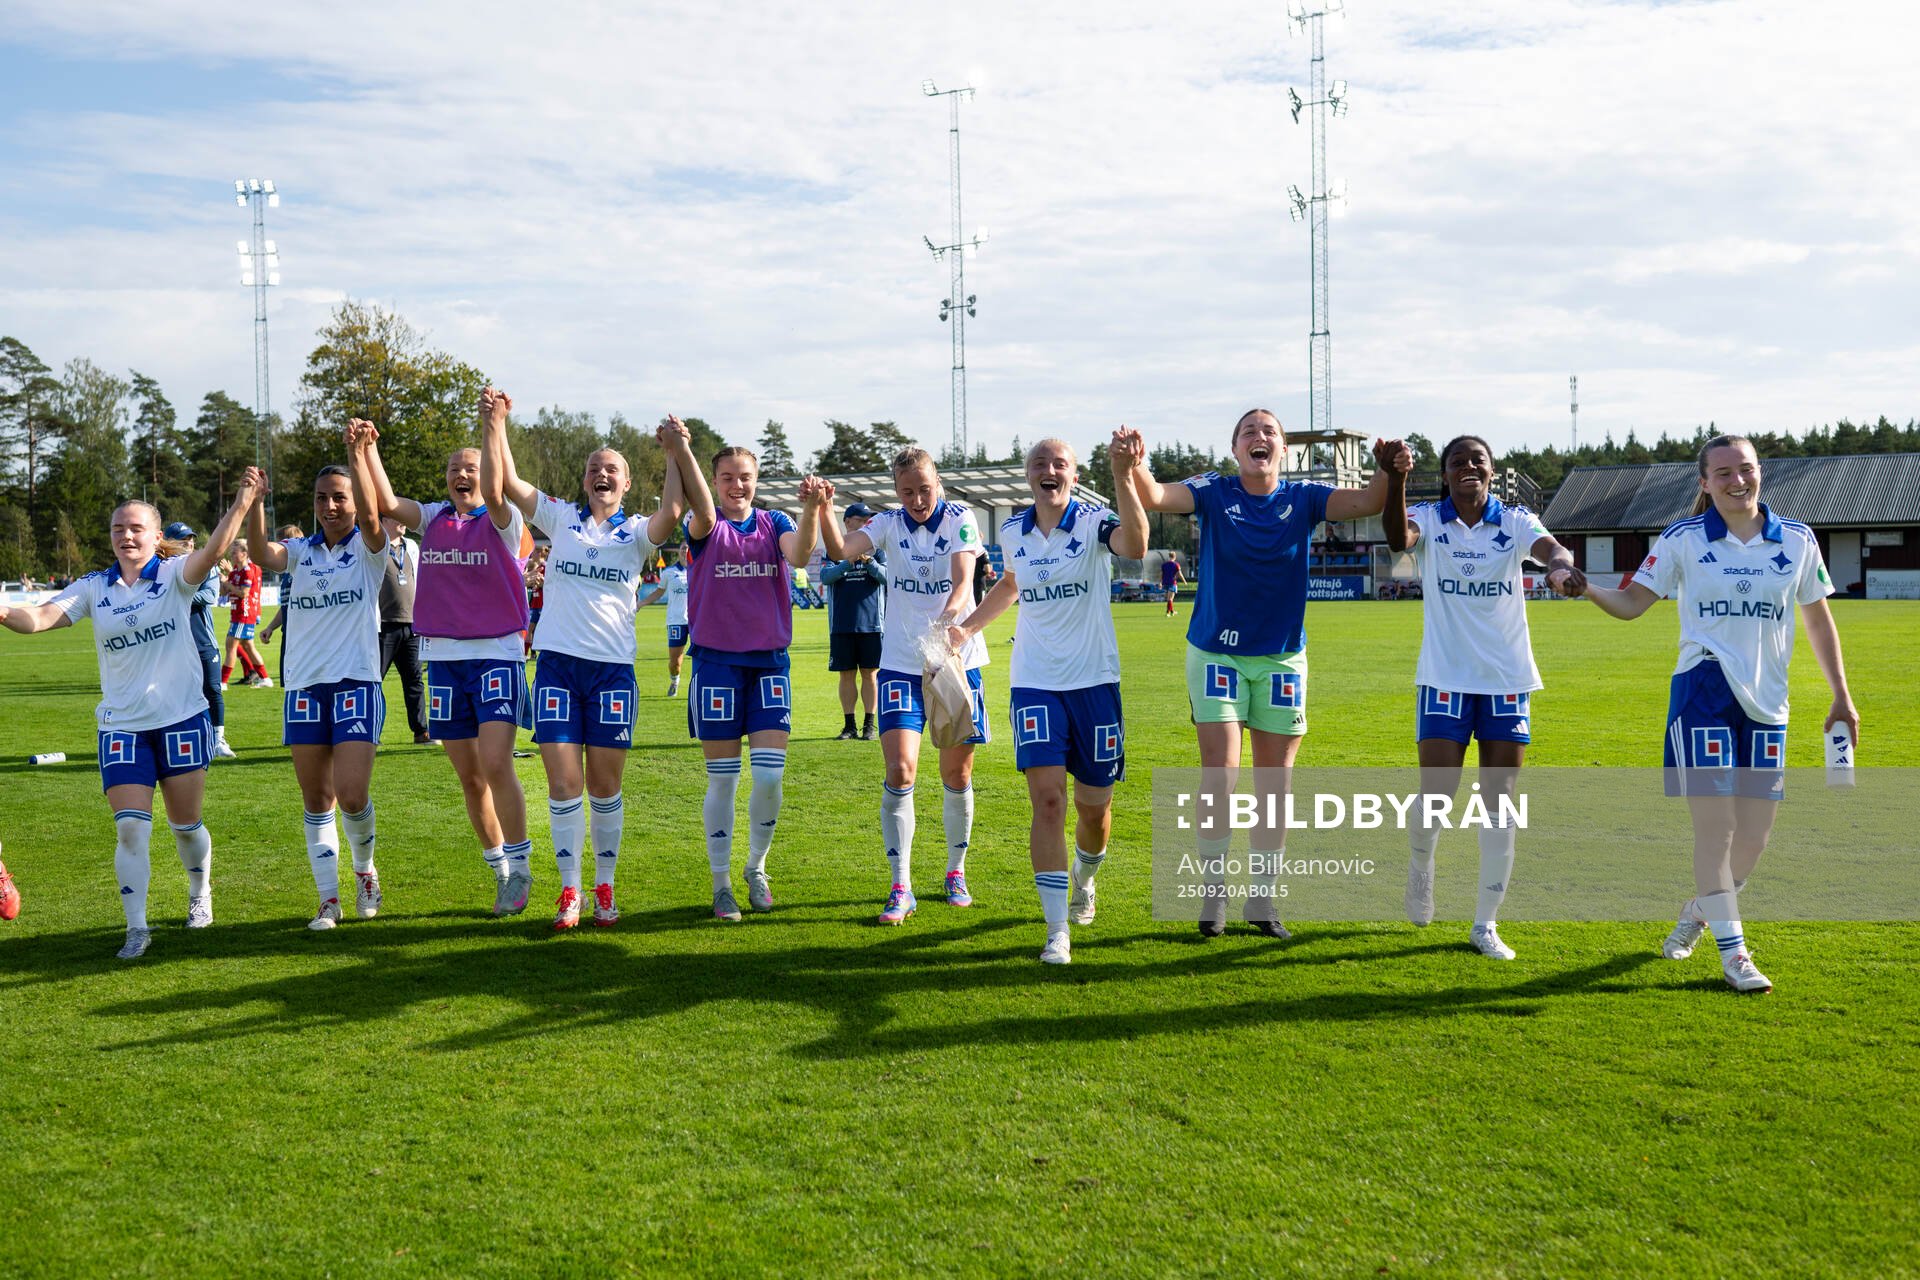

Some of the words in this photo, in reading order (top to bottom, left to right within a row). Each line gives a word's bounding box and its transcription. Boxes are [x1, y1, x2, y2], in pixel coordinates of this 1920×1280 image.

[421, 548, 488, 565] stadium
[1452, 551, 1487, 559] stadium
[555, 559, 630, 583] HOLMEN
[714, 561, 778, 578] stadium
[1722, 566, 1764, 576] stadium
[894, 576, 953, 595] HOLME
[1020, 580, 1088, 602] OLMEN
[1309, 579, 1343, 591] Vittsjö
[290, 588, 363, 609] HOLMEN
[1307, 589, 1355, 600] rottspark
[112, 601, 145, 615] stadium
[1698, 600, 1785, 621] HOLMEN
[102, 618, 176, 652] HOLMEN
[1219, 628, 1239, 646] 40
